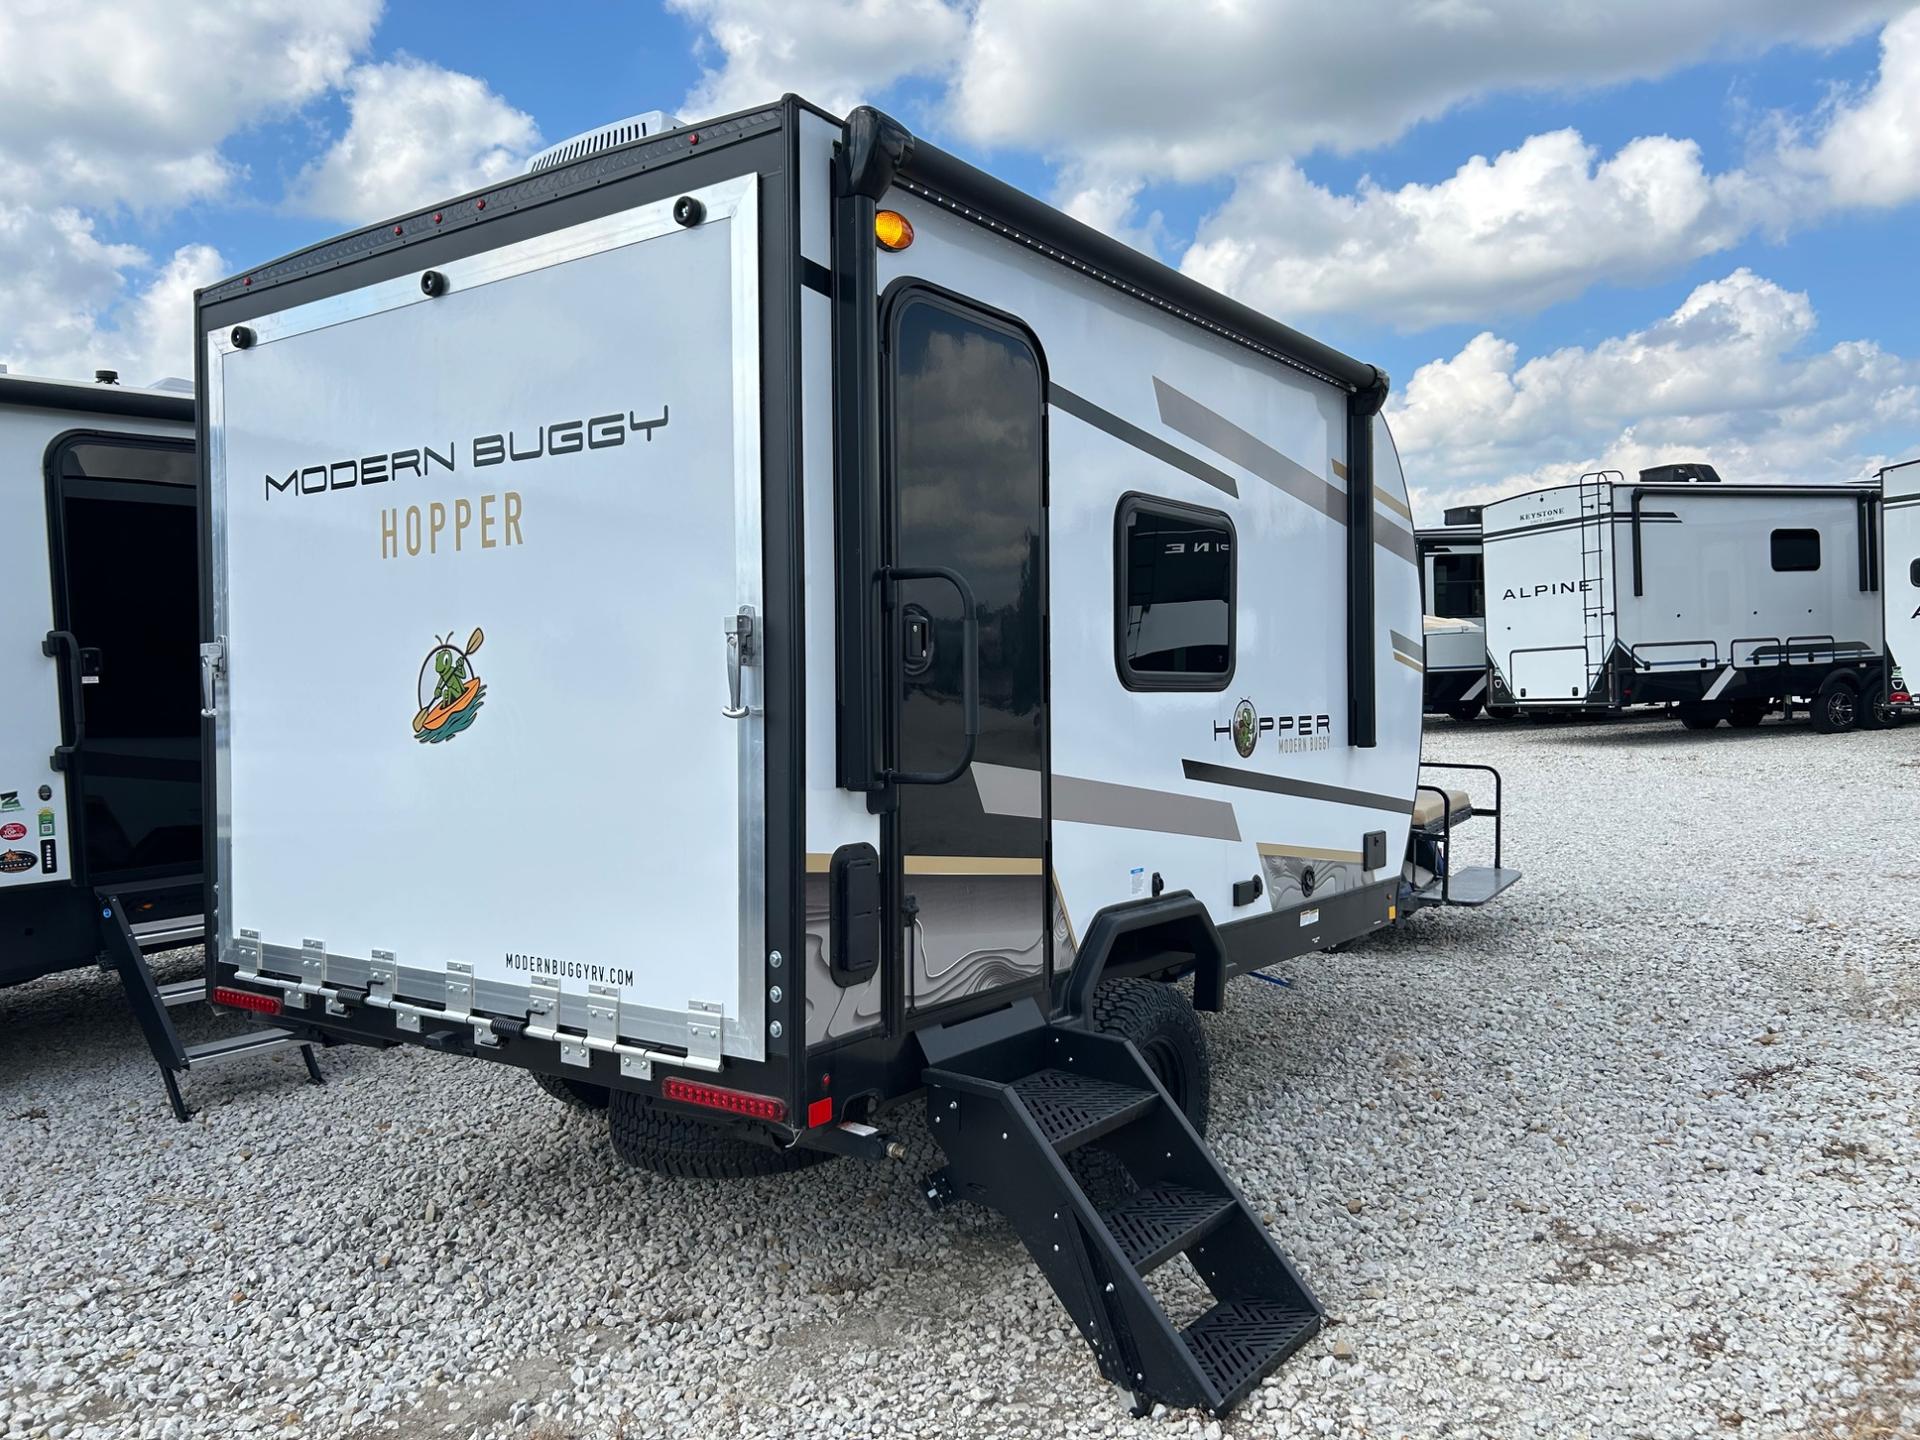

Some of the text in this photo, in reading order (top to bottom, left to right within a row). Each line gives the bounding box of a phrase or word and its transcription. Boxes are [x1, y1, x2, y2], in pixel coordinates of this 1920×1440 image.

[265, 404, 670, 501] MODERN BUGGY
[381, 491, 524, 560] HOPPER
[1519, 507, 1565, 521] KEYSTONE
[1502, 580, 1593, 600] ALPINE
[1279, 735, 1331, 754] MODERN BUGGY
[505, 952, 634, 987] MODERNBUGGYRV.COM
